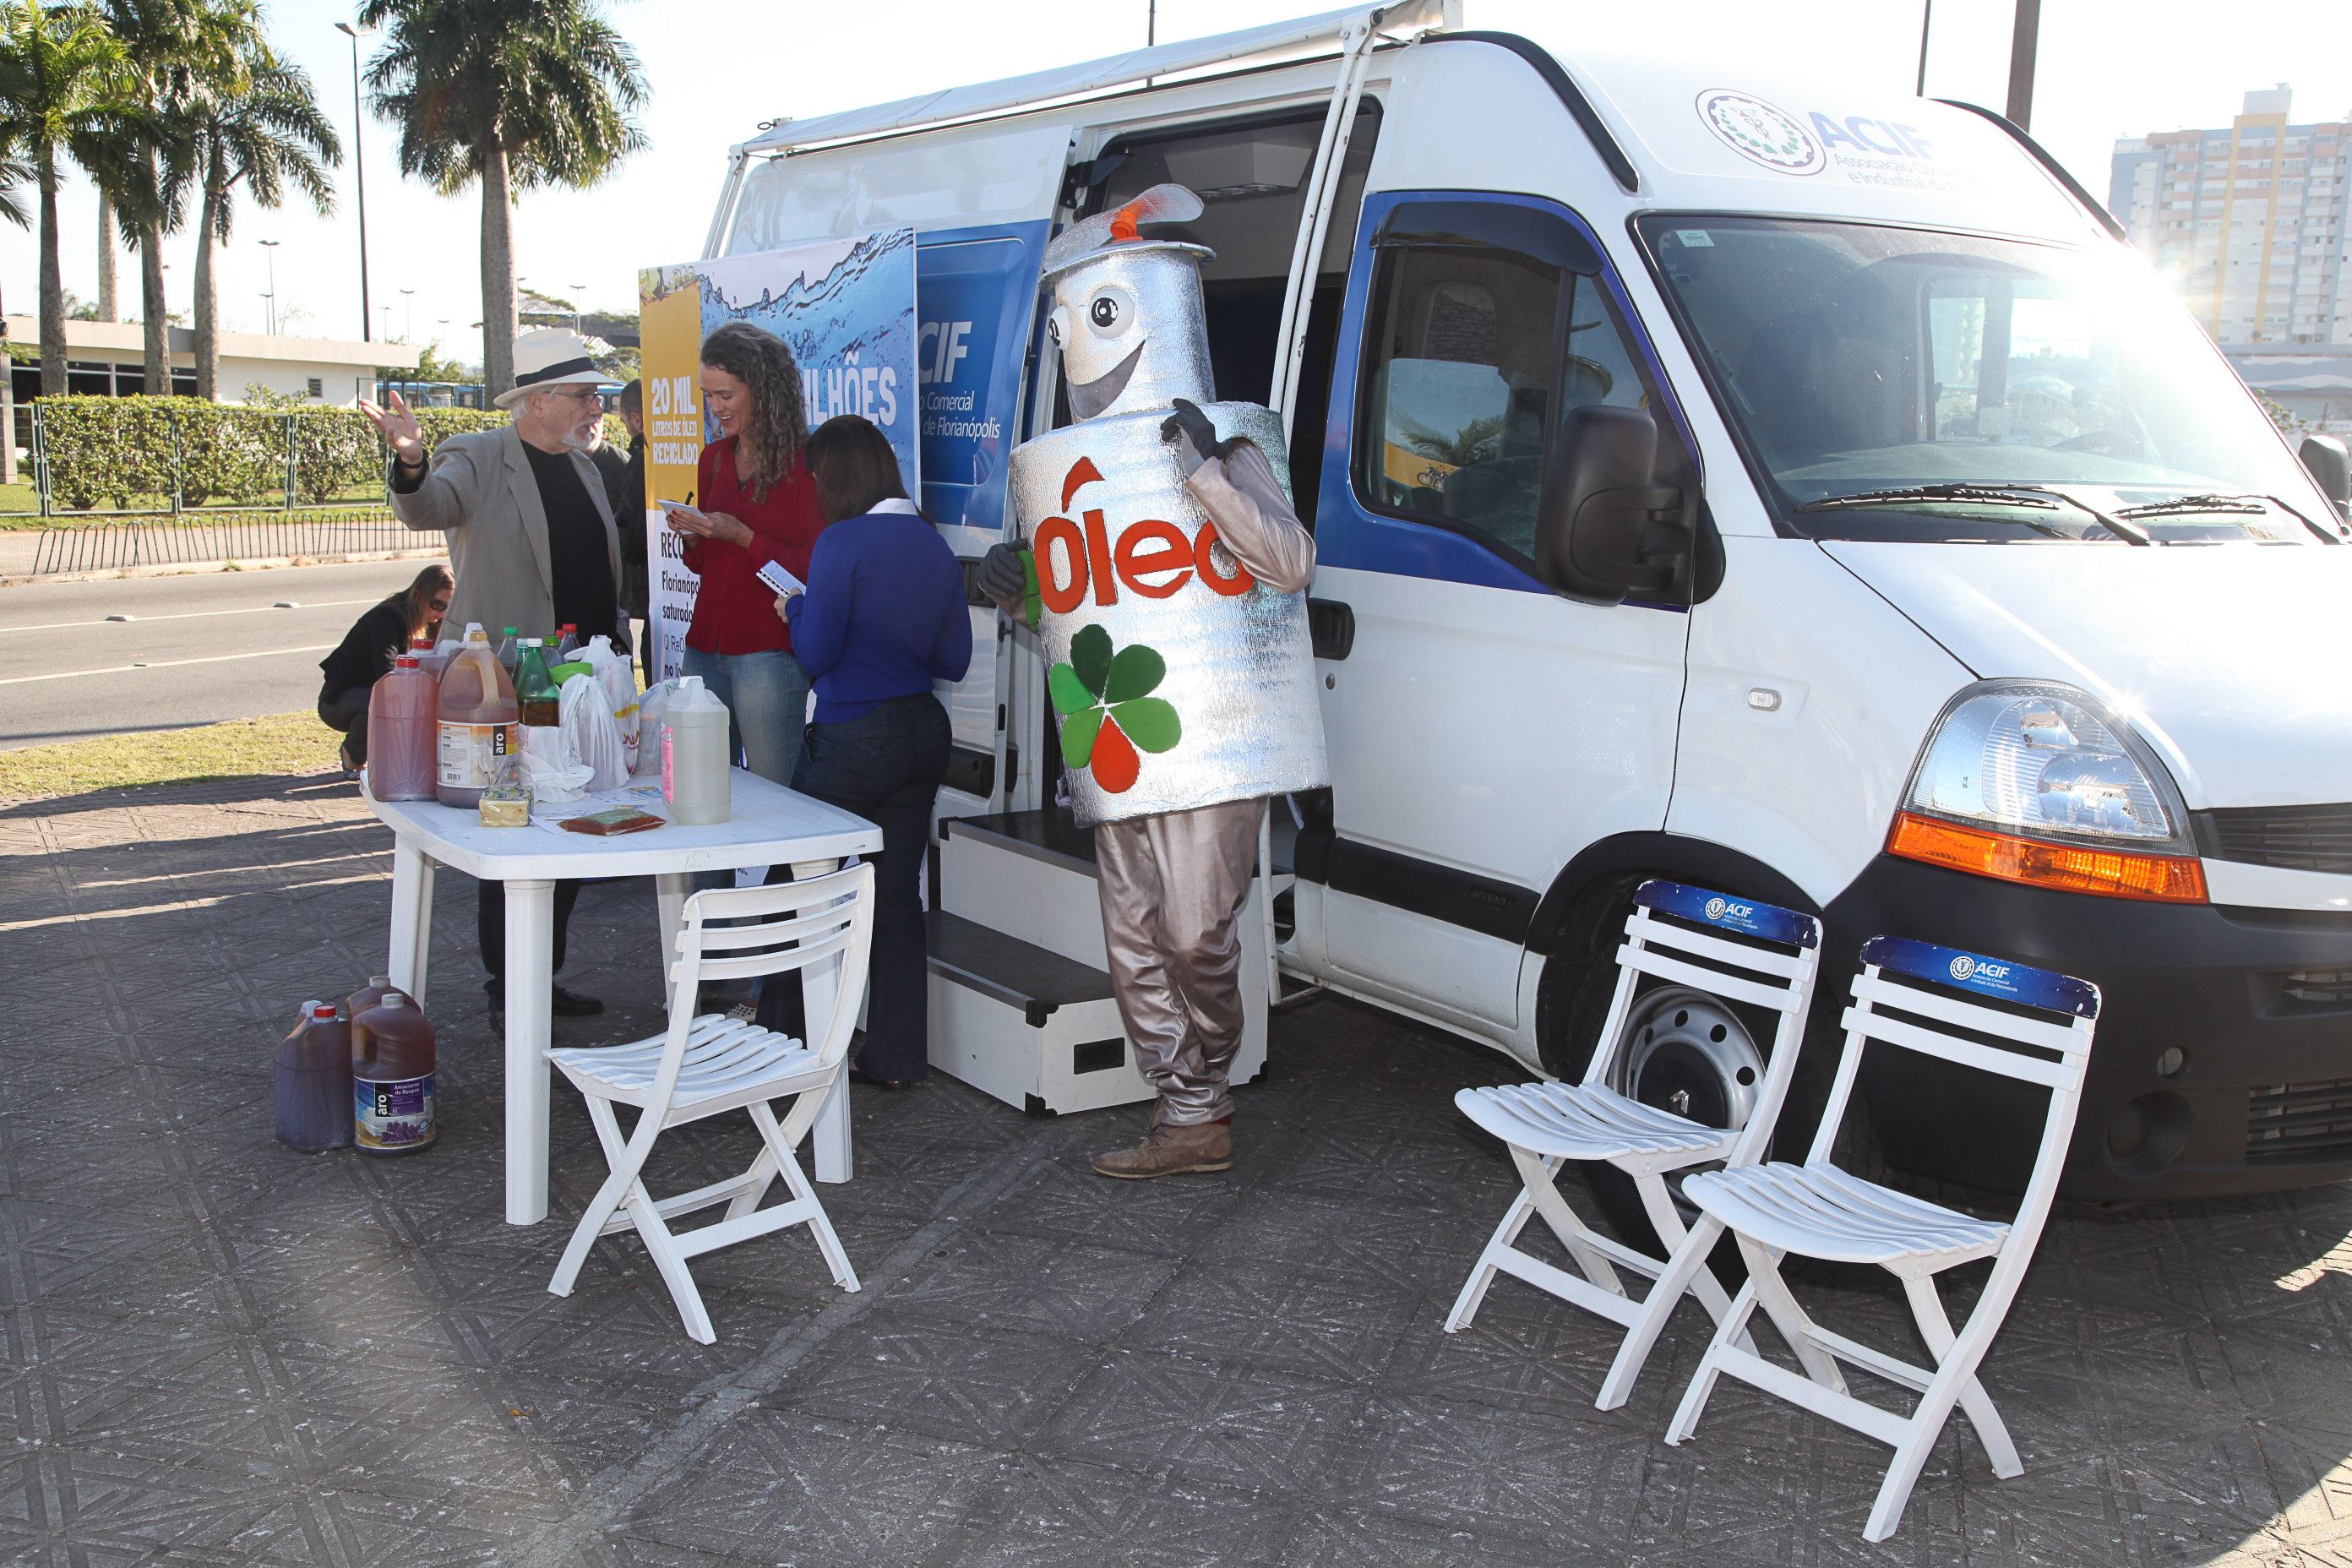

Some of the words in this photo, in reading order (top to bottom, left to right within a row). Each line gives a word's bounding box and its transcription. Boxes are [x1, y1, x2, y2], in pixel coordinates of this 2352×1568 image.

[1807, 111, 1934, 161] ACIF
[1833, 153, 1914, 174] Associação
[1858, 171, 1929, 190] Industrial
[918, 321, 972, 384] CIF
[651, 377, 671, 415] 20
[672, 375, 697, 415] MIL
[803, 351, 897, 426] ILHÕES
[927, 390, 975, 411] Comercial
[651, 420, 672, 437] LITROS
[673, 420, 681, 436] DE
[682, 416, 698, 437] ÓLEO
[923, 416, 935, 436] de
[937, 416, 1001, 443] Florianópolis
[653, 442, 699, 466] RECICLADO
[664, 664, 673, 677] no
[495, 732, 504, 754] aro
[1724, 902, 1754, 918] ACIF
[402, 1087, 420, 1096] Roupas
[378, 1094, 388, 1115] aro
